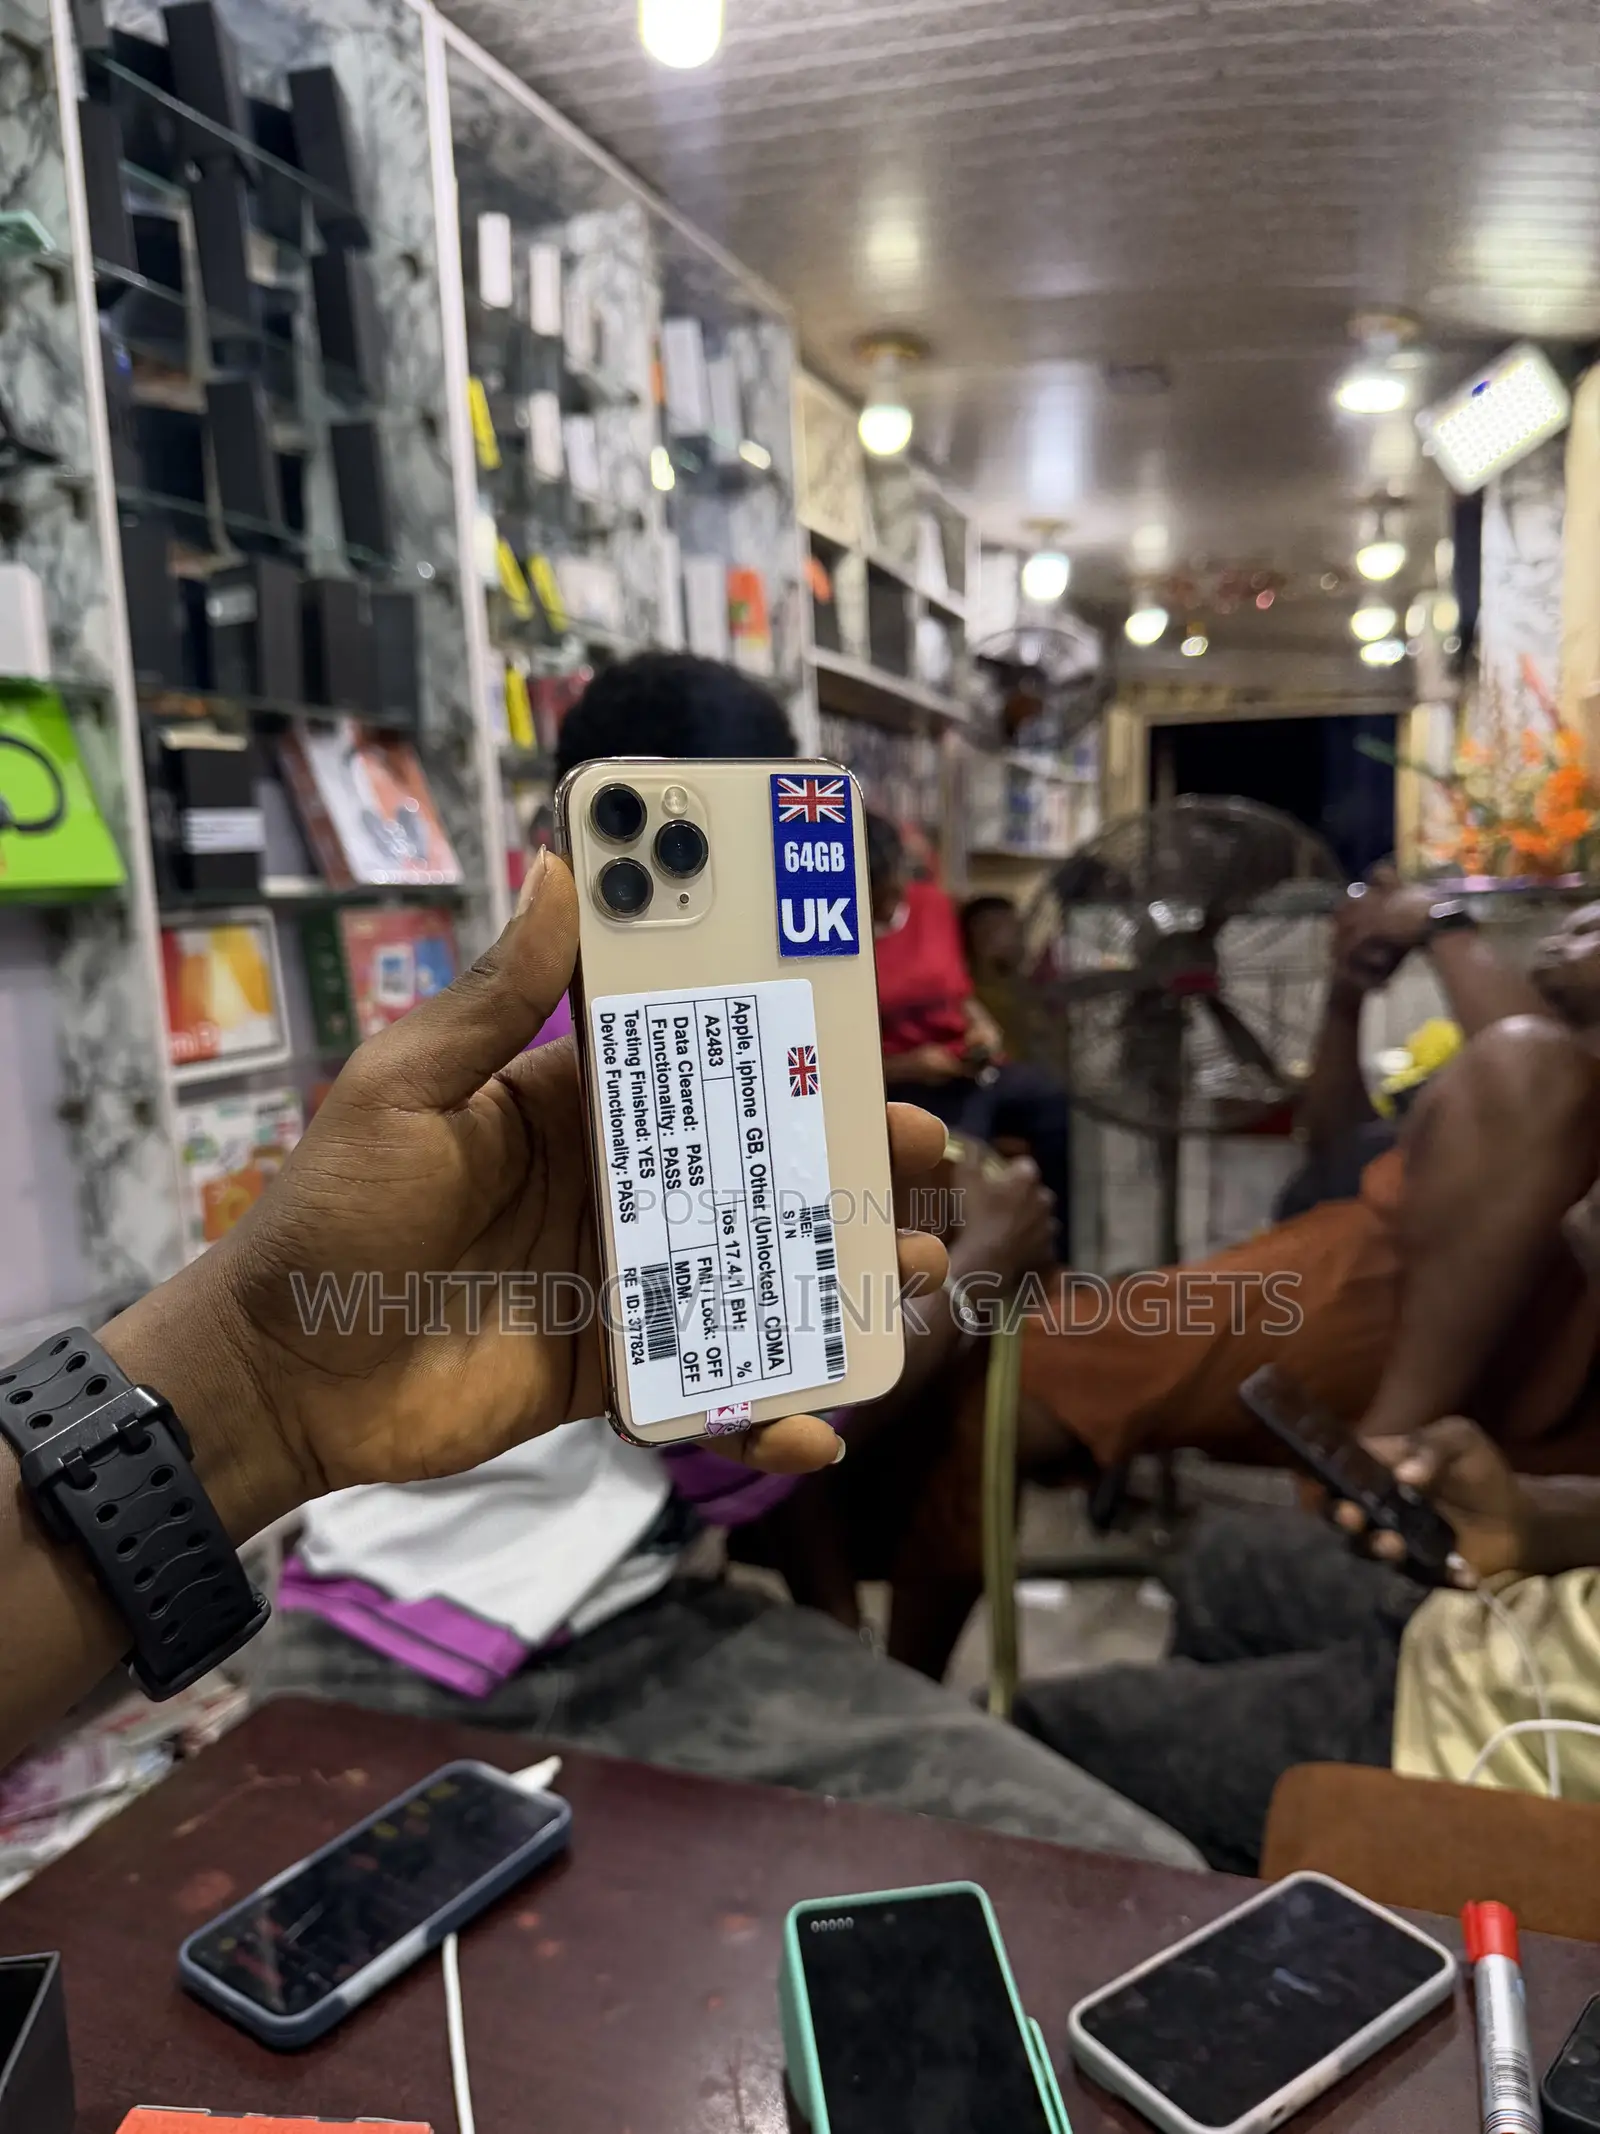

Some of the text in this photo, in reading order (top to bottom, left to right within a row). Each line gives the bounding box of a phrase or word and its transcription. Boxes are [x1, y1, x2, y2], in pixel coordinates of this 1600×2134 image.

[784, 841, 846, 873] 64GB
[781, 898, 854, 943] UK
[704, 1014, 724, 1067] A2483
[600, 1012, 636, 1224] Device Functionality: PASS
[624, 1009, 655, 1179] Testing Finished: YES
[651, 1018, 682, 1190] Functionality: PASS
[673, 1016, 705, 1187] Data Cleared: PASS
[731, 1001, 785, 1371] Apple, iphone GB, Other (Unlocked) CDMA
[697, 1257, 714, 1285] FMI
[725, 1241, 744, 1288] 17.4.1
[623, 1267, 645, 1366] RE ID: 377824
[675, 1261, 701, 1383] MDM: OFF
[701, 1298, 718, 1340] Lock:
[731, 1298, 753, 1378] BH: %
[706, 1346, 723, 1378] OFF
